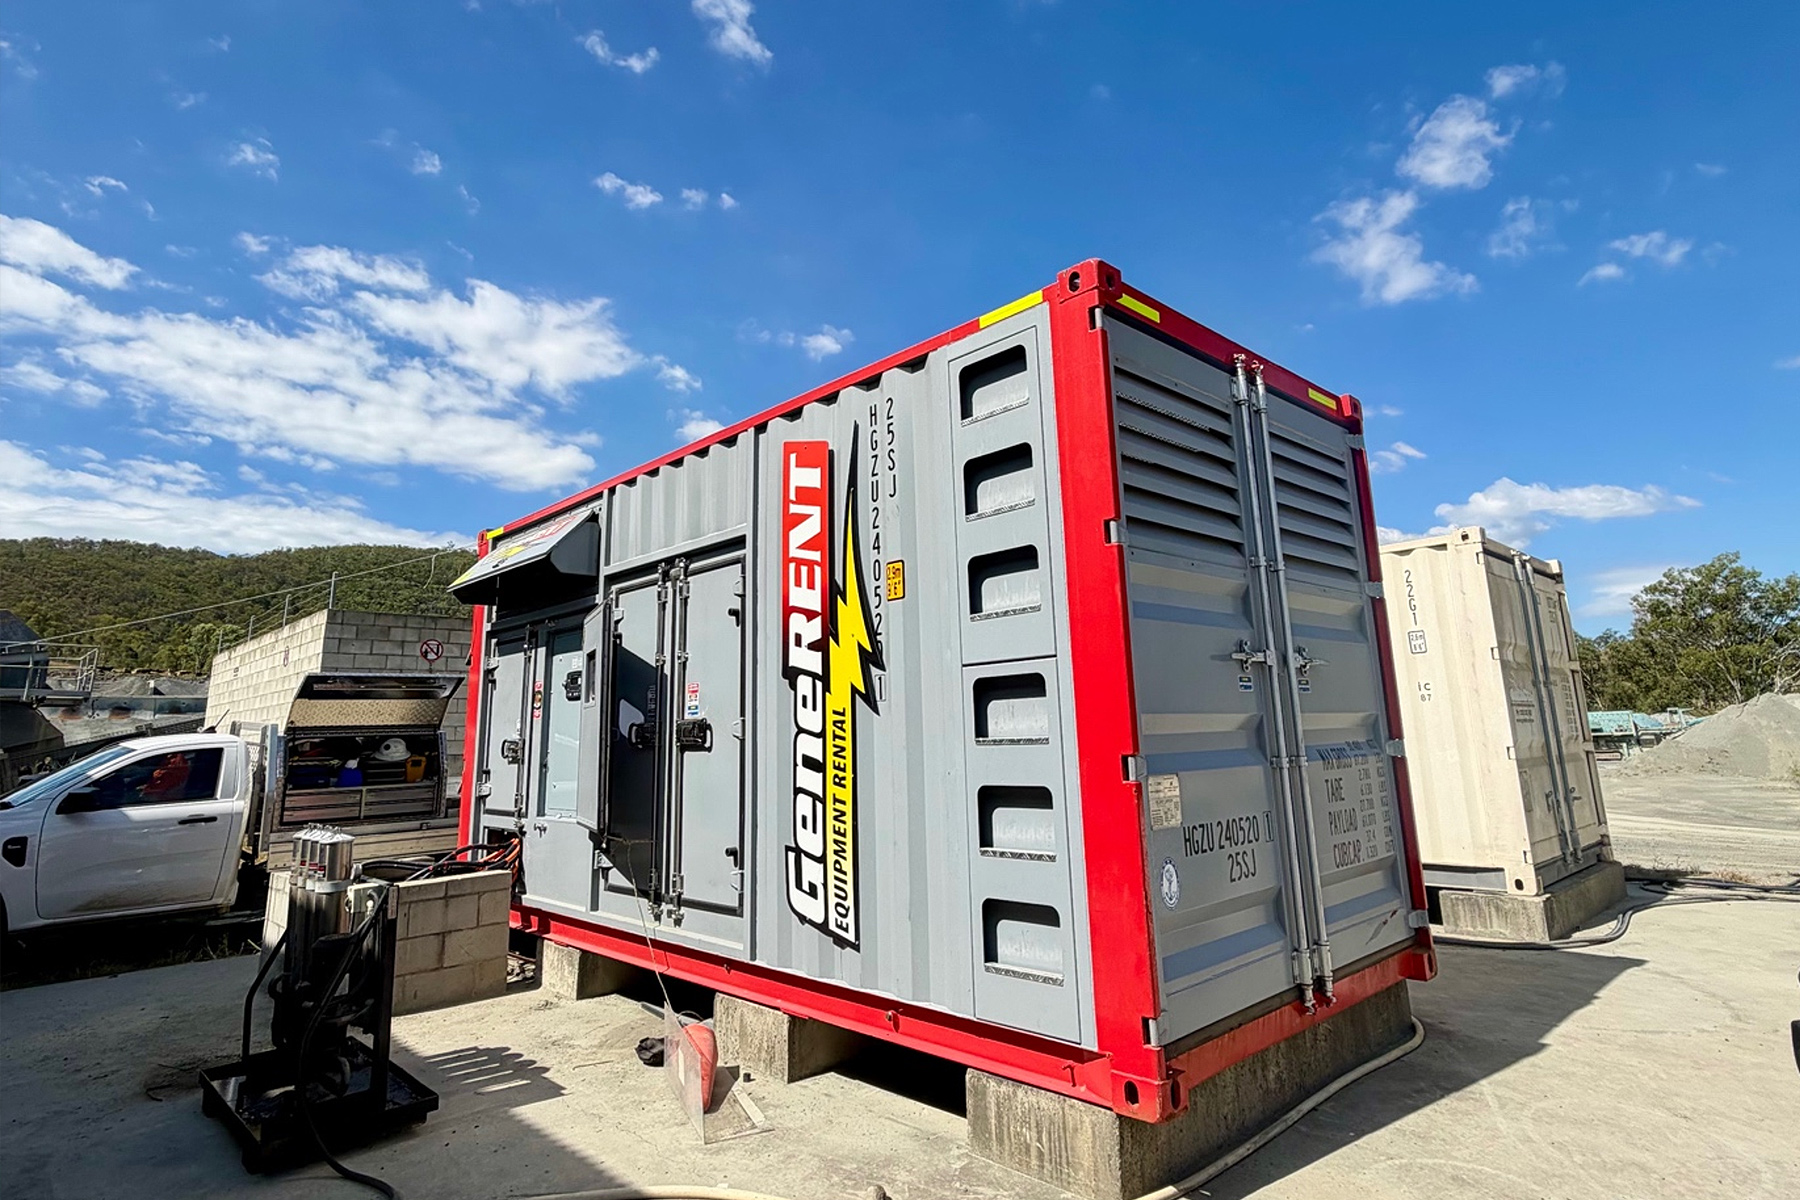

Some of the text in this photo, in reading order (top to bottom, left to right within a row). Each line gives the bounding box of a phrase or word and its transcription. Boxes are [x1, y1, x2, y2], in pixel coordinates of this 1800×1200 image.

[886, 397, 896, 498] 25SJ
[1404, 569, 1418, 626] 22G1
[786, 452, 827, 926] GeneRENT
[1325, 777, 1345, 804] TARE
[831, 706, 850, 934] EQUIPMENT RENTAL
[1183, 822, 1215, 857] HGZU
[1216, 815, 1260, 850] 240520
[1328, 807, 1358, 836] PAYLOAD
[1227, 848, 1257, 883] 25SJ
